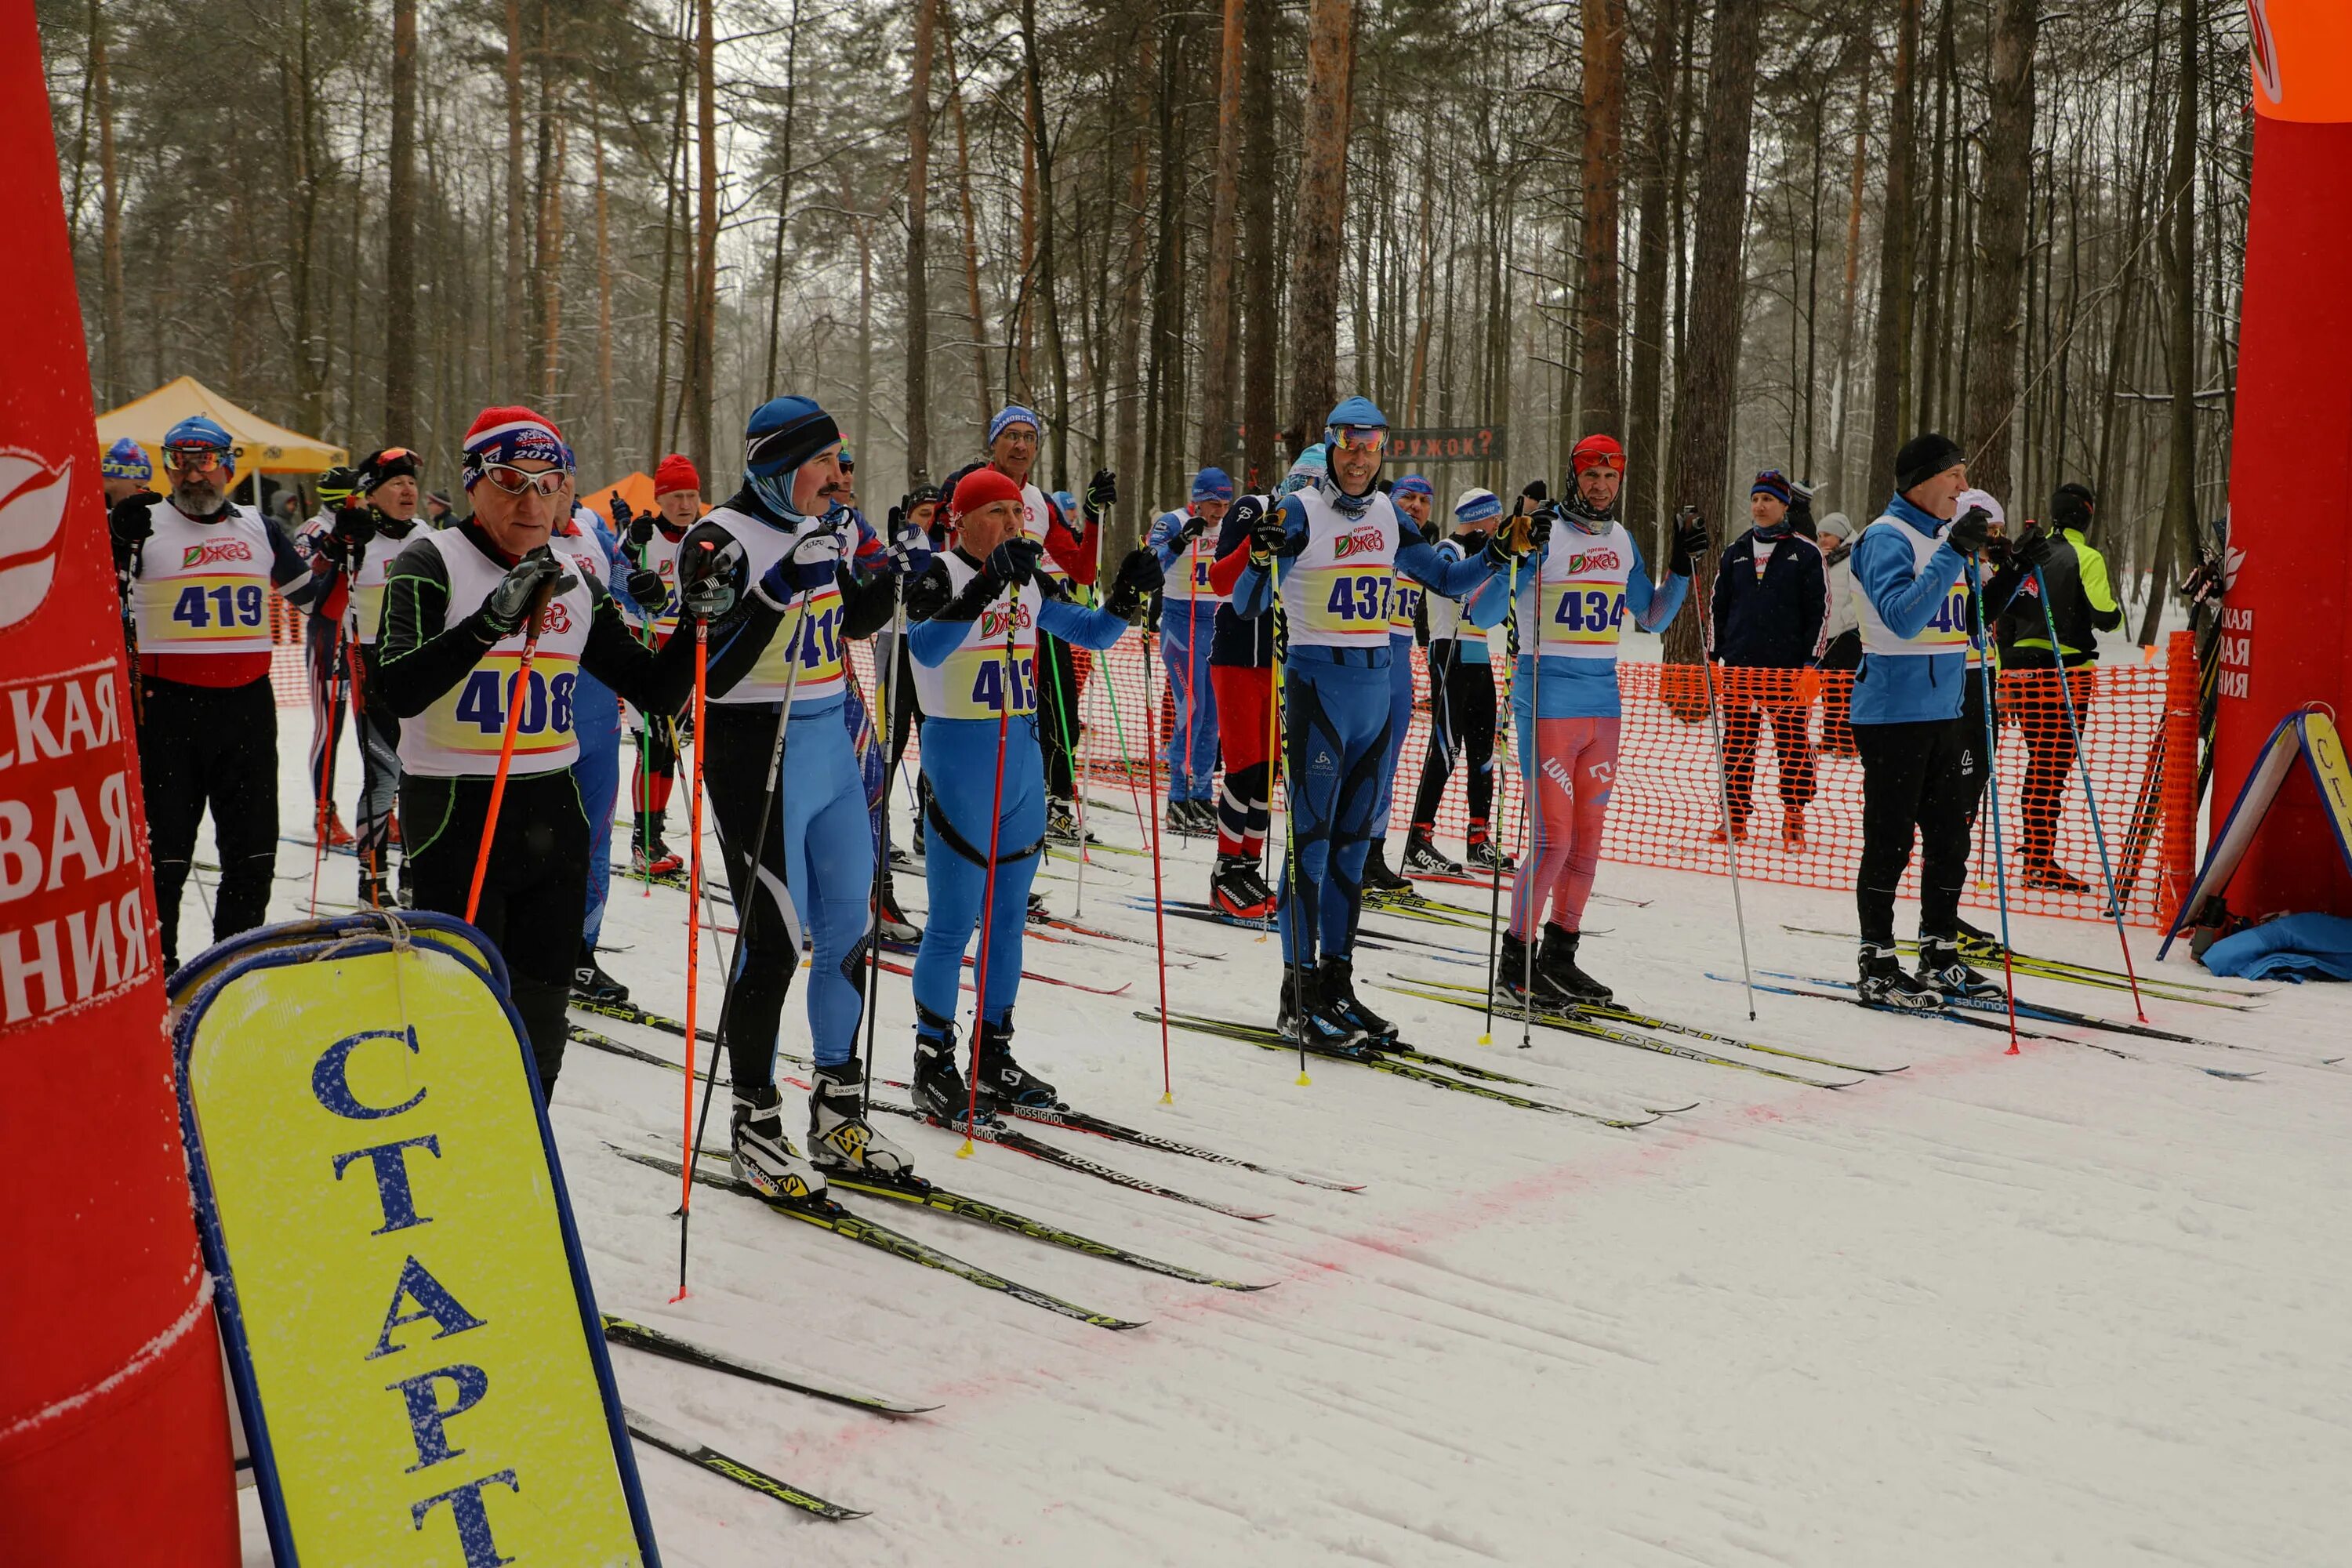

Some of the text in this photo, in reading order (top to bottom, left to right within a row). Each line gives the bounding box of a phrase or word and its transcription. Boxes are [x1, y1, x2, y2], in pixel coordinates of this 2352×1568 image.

[1384, 430, 1493, 457] РУЖОК?
[1353, 524, 1374, 534] орешки
[173, 585, 263, 628] 419
[1327, 575, 1392, 620] 437
[1390, 587, 1421, 619] 15
[1555, 591, 1625, 633] 434
[456, 670, 577, 735] 408
[972, 658, 1037, 711] 413
[0, 673, 121, 768] КАЯ
[1541, 757, 1575, 804] LUKO
[1218, 884, 1246, 908] MADSHUS
[0, 887, 150, 1025] НИЯ
[1491, 1008, 1542, 1024] FISCHER
[1955, 997, 2009, 1012] salomon
[927, 1082, 949, 1104] salomon
[1014, 1106, 1065, 1125] ROSSIGNOL
[1134, 1131, 1248, 1168] ROSSIGNOL
[750, 1163, 779, 1193] salomon
[1059, 1152, 1166, 1196] ROSSIGNOL
[311, 1023, 521, 1568] СТАРТ
[705, 1457, 826, 1512] FISCHER
